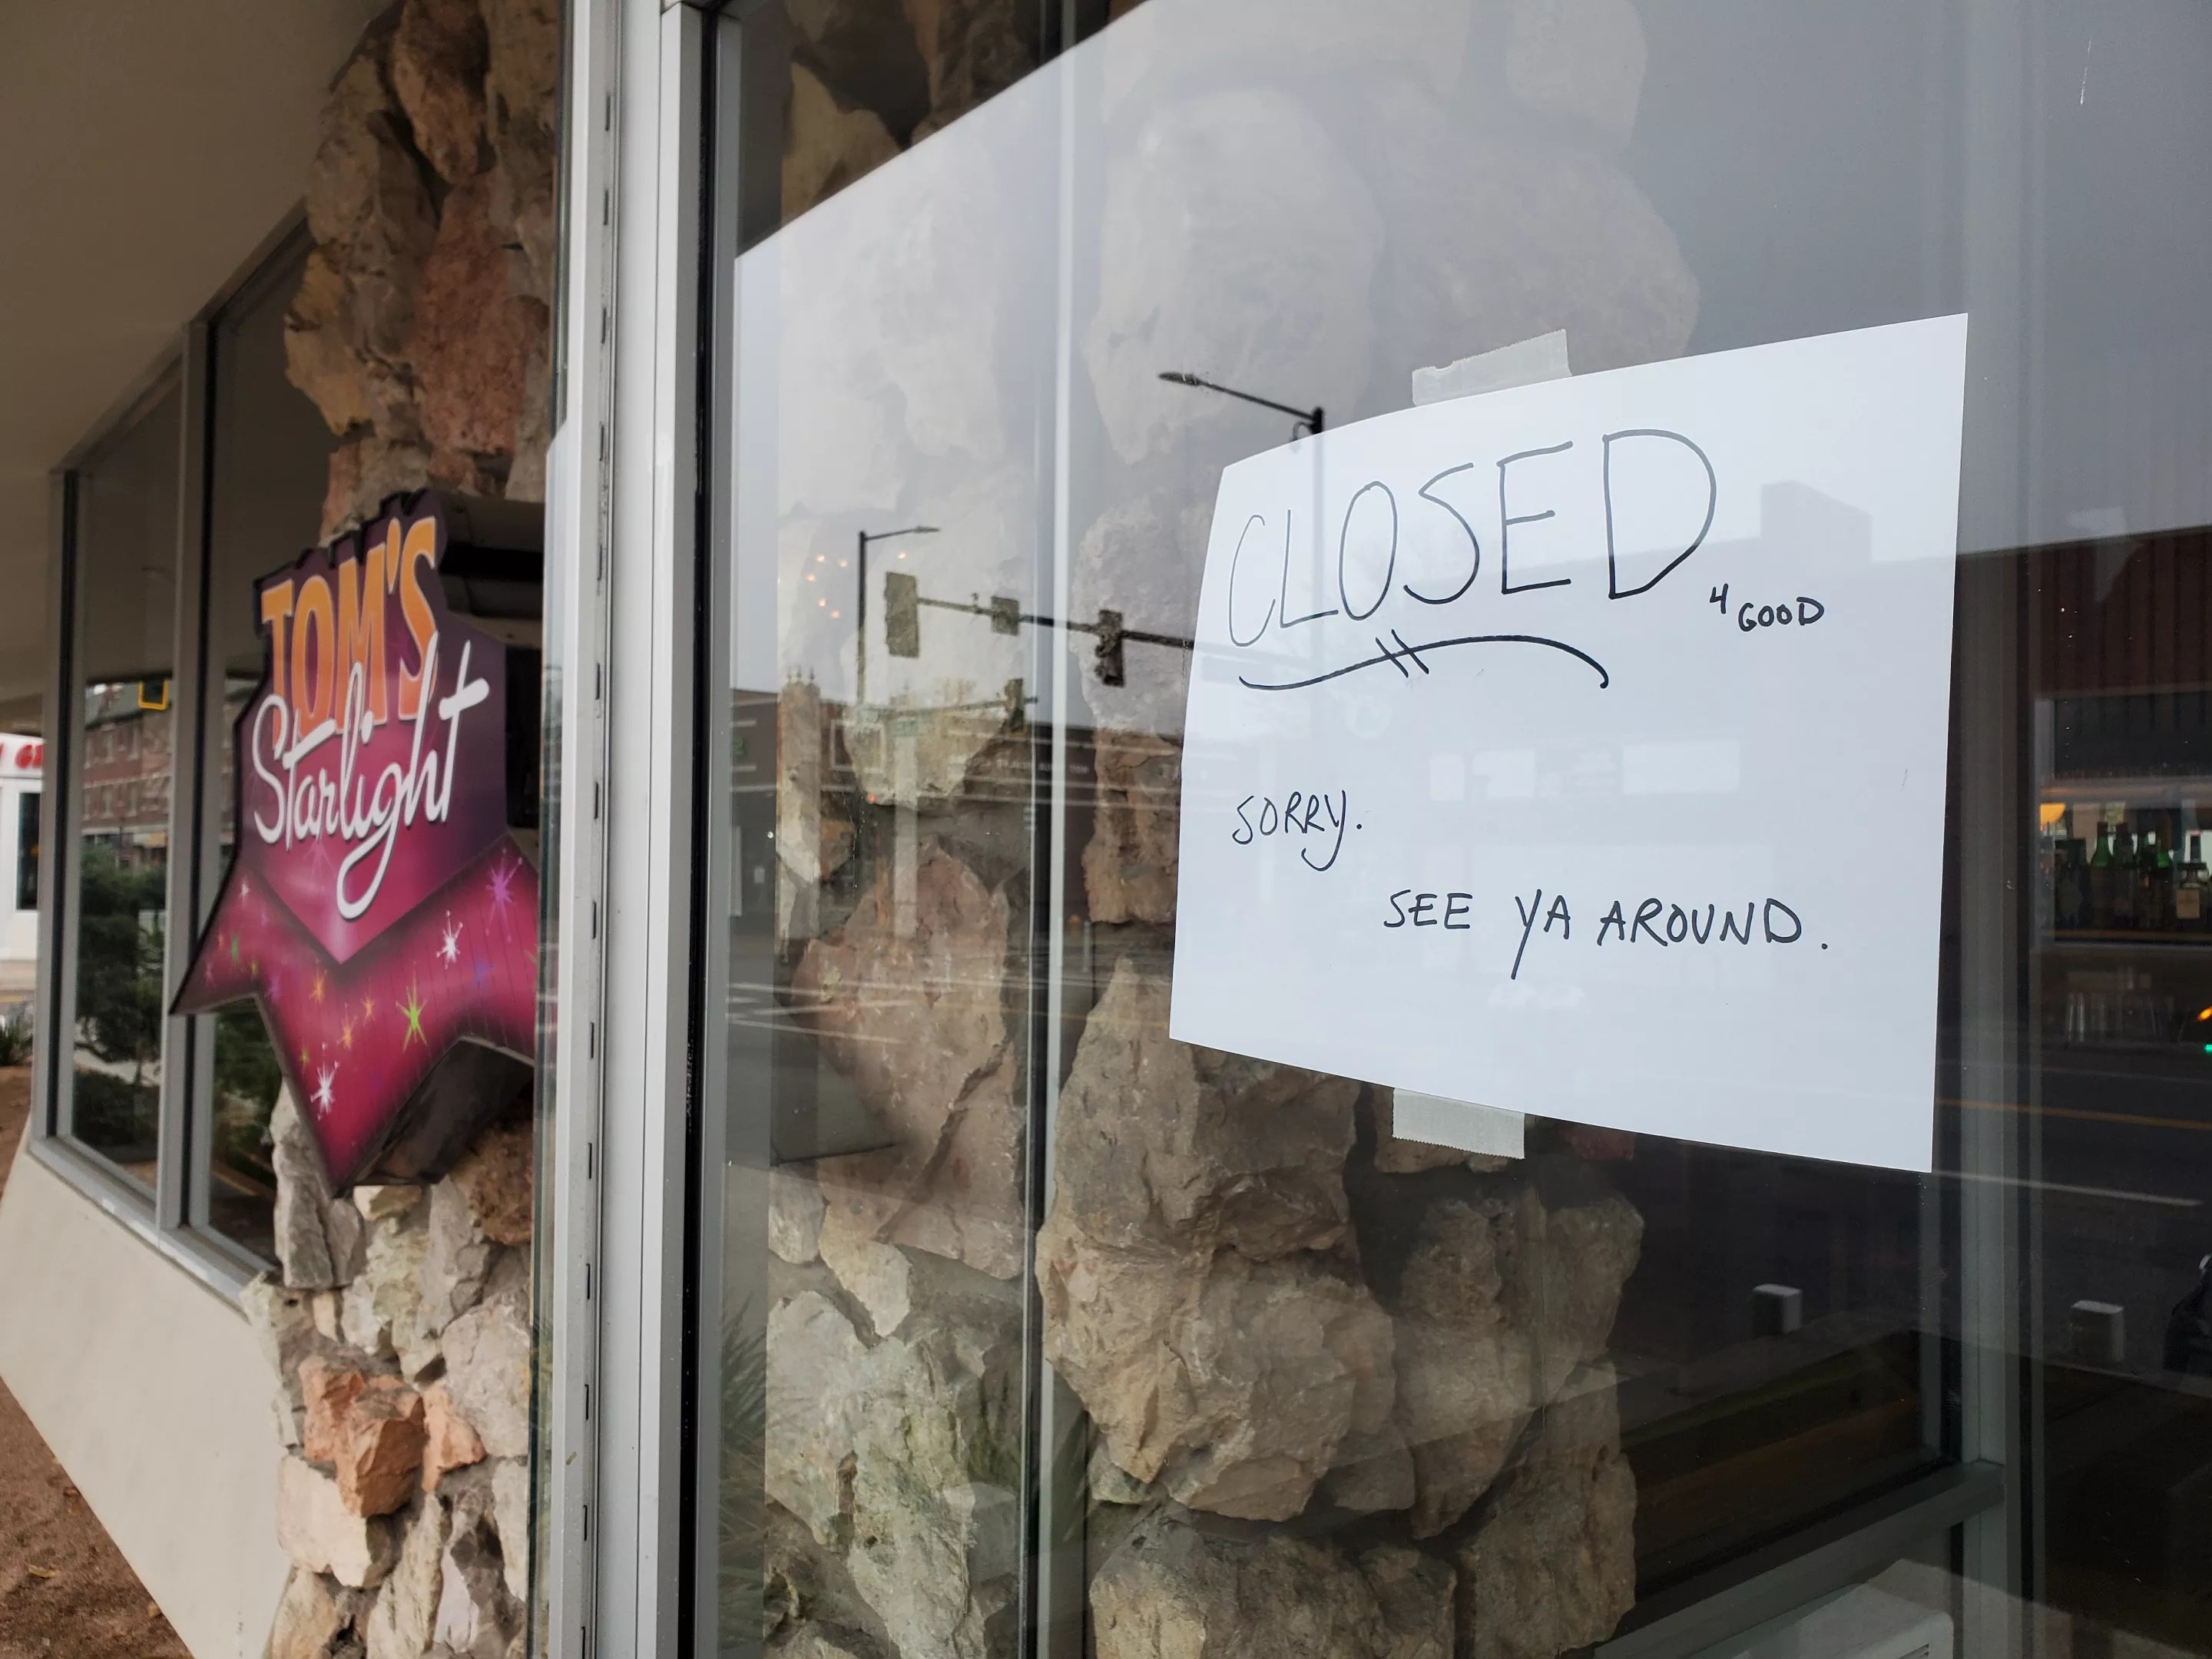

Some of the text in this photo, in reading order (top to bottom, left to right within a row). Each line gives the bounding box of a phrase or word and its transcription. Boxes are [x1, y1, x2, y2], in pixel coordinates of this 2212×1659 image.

[1229, 429, 1717, 647] CLOSED
[1709, 583, 1825, 632] 4 GOOD
[262, 516, 439, 743] TOM'S
[253, 631, 489, 919] Starlight
[1231, 789, 1363, 872] SORRY.
[1383, 889, 1829, 981] SEE YA AROUND.
